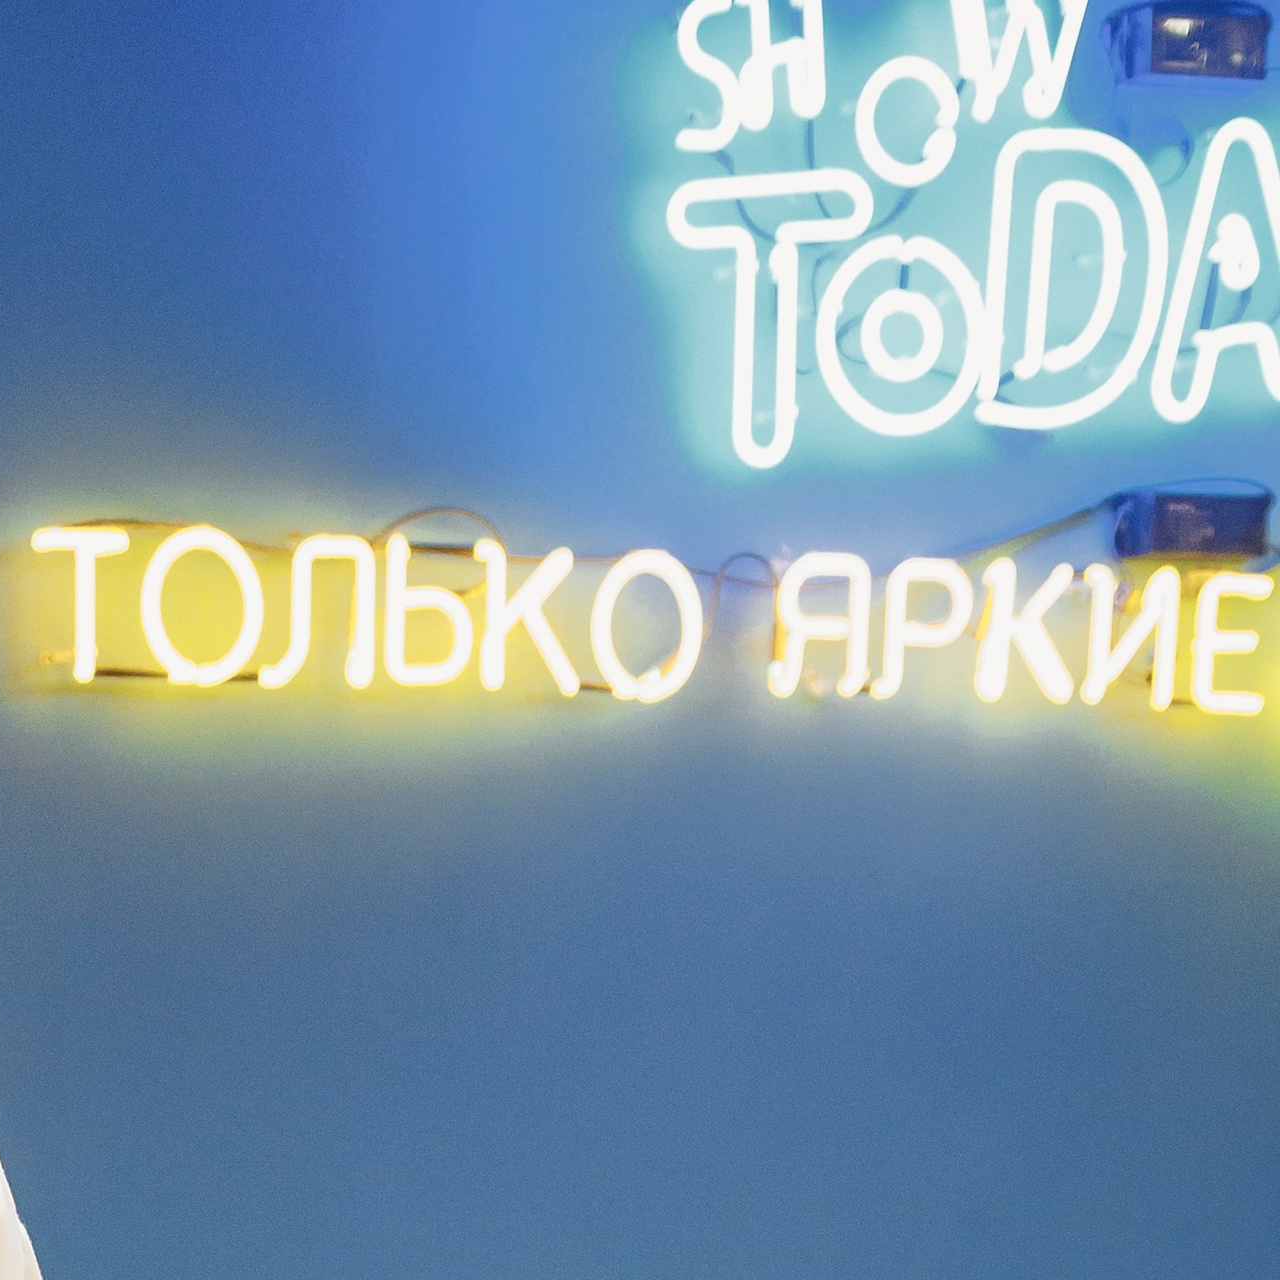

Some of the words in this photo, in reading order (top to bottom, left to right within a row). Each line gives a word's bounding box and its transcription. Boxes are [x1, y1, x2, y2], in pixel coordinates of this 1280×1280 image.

[675, 0, 1089, 187] SHOW
[31, 523, 706, 702] ТОЛЬКО
[767, 550, 1276, 715] ЯРКИЕ
